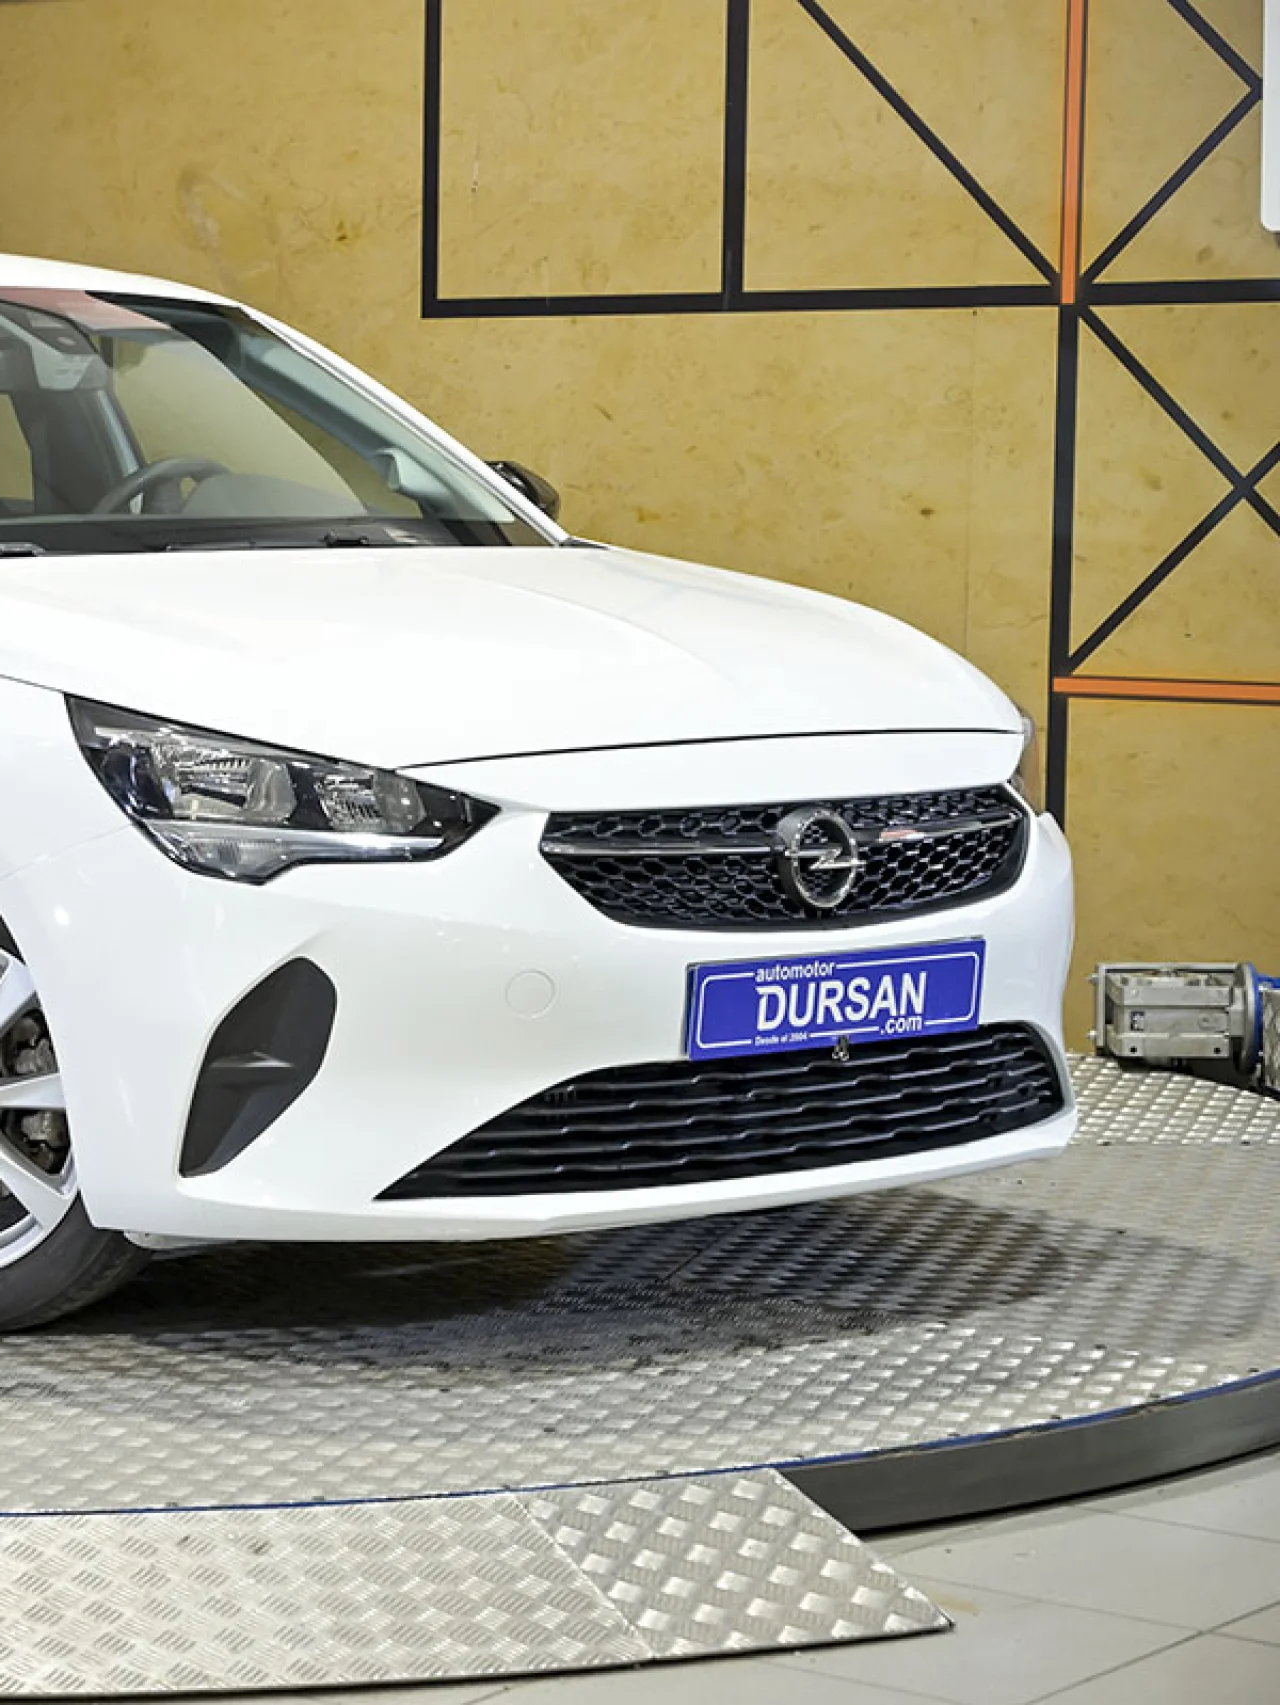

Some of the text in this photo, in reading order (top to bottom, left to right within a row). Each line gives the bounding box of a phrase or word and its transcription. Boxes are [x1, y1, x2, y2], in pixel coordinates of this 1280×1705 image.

[755, 961, 835, 982] automotor
[755, 971, 927, 1031] DURSAN
[880, 1015, 923, 1035] .com
